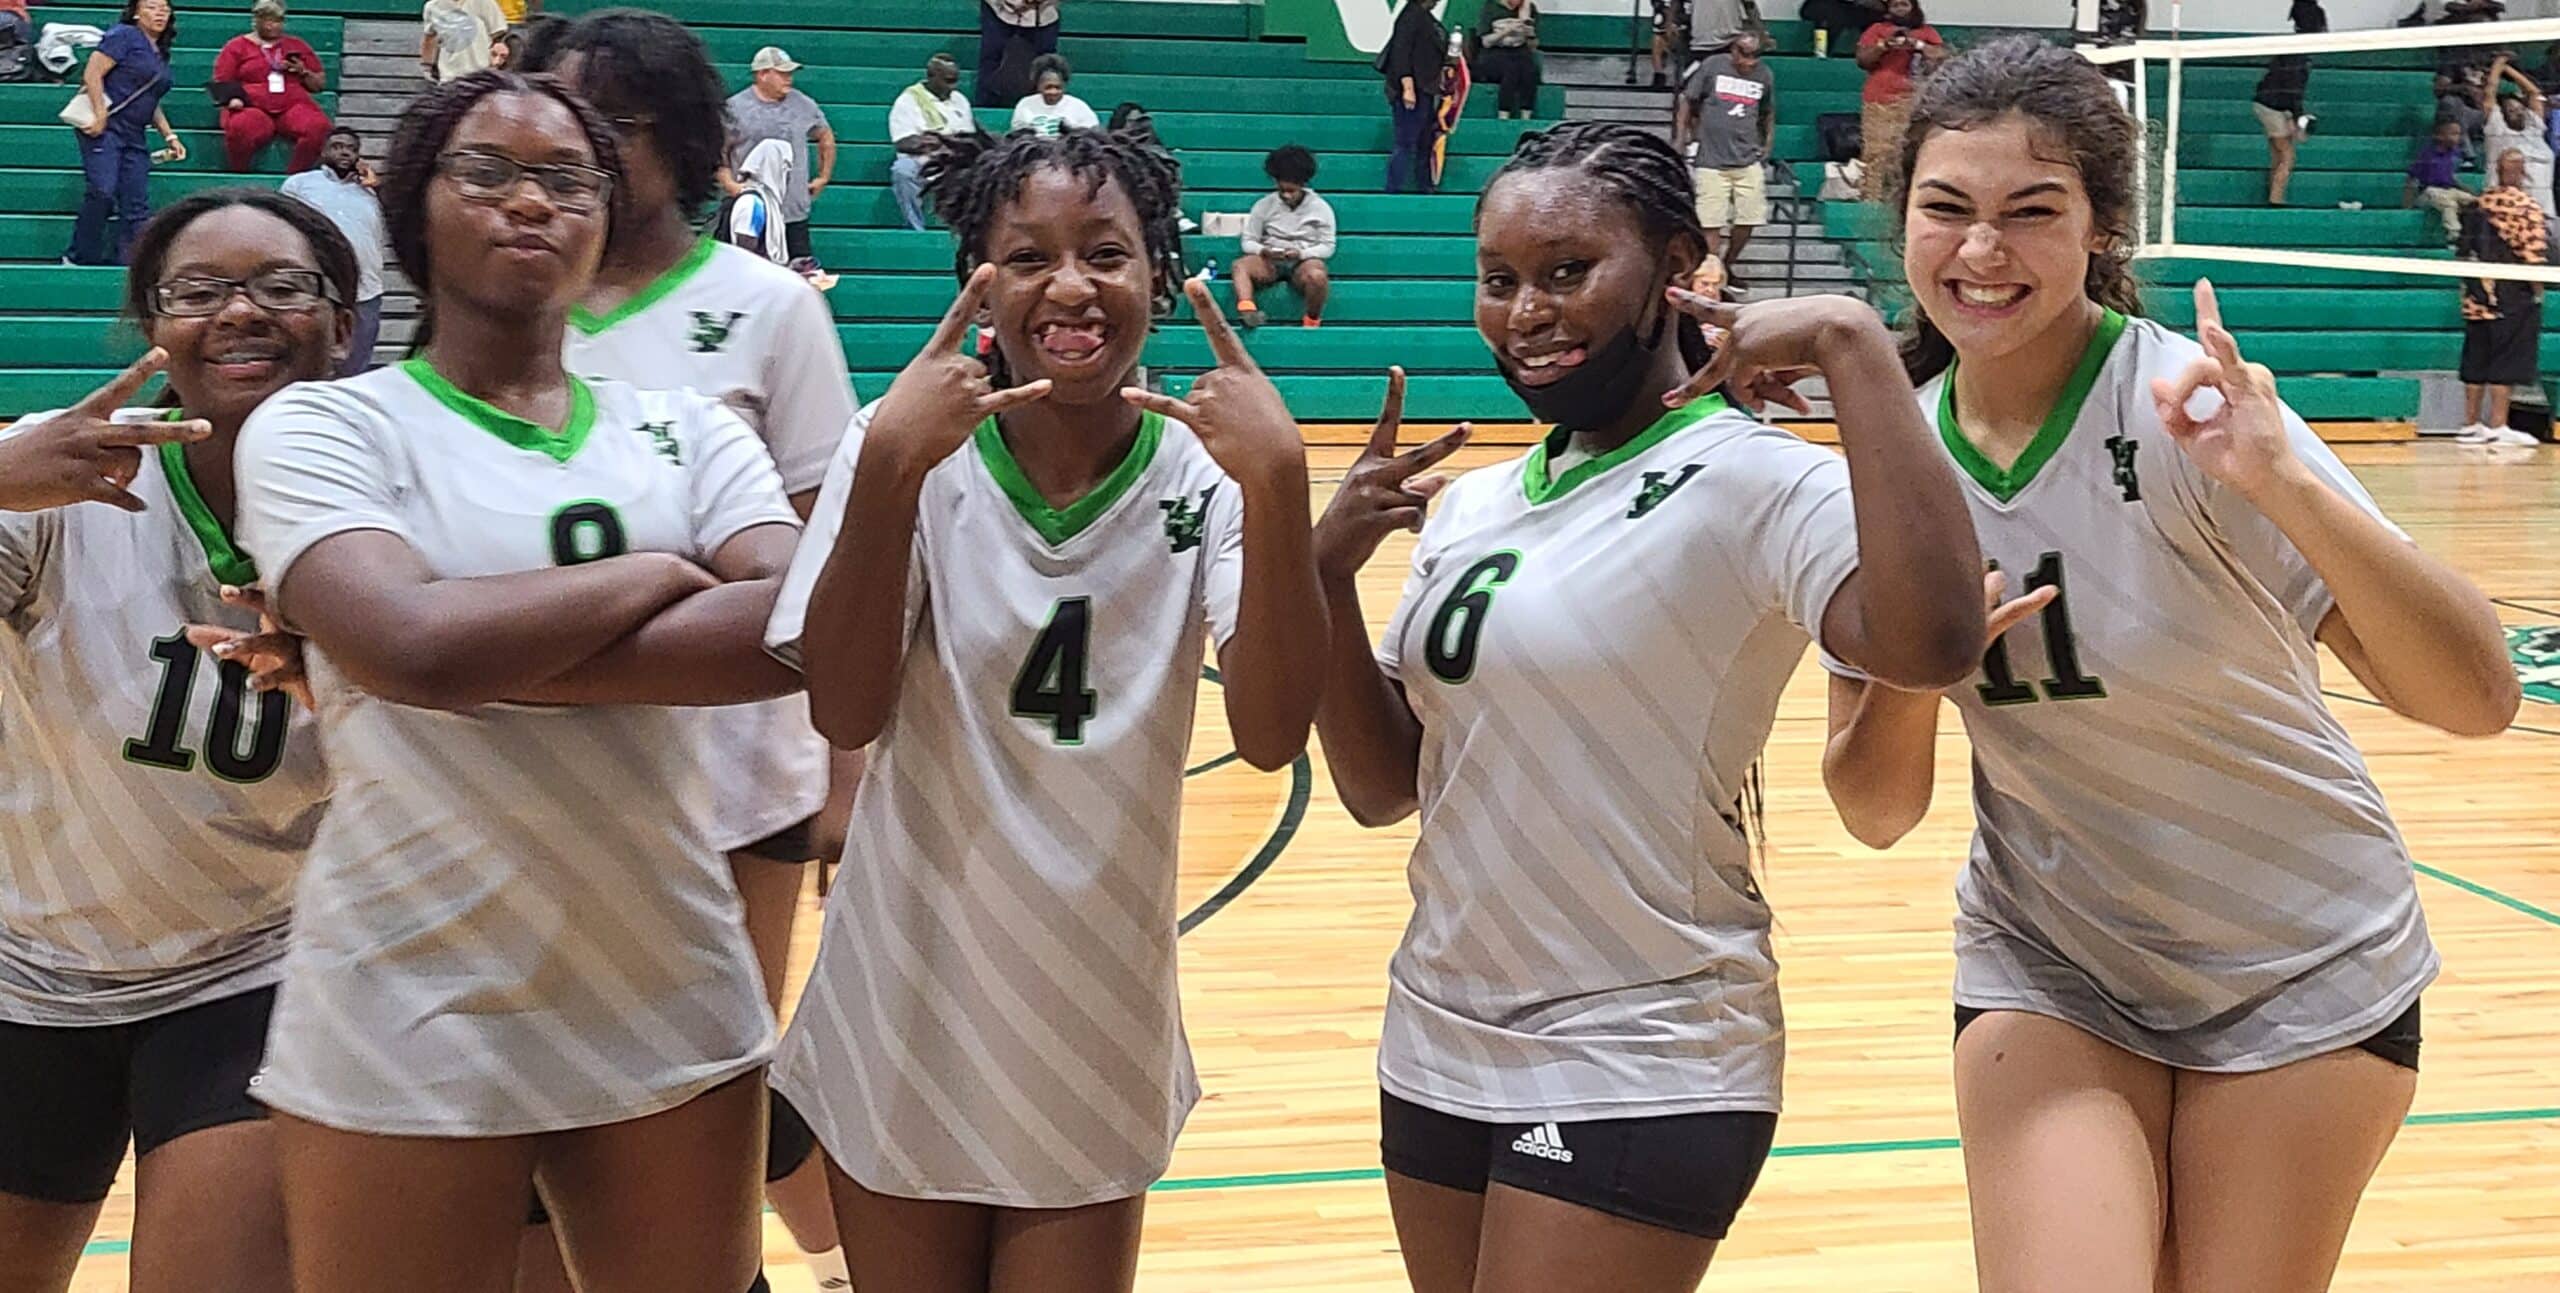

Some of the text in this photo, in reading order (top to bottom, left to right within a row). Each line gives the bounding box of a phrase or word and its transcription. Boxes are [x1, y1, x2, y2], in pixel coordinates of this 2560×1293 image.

[1009, 595, 1098, 745] 4
[1424, 549, 1523, 685] 6
[1974, 551, 2107, 706] 11
[123, 625, 291, 784] 10
[1511, 1139, 1574, 1163] adidas
